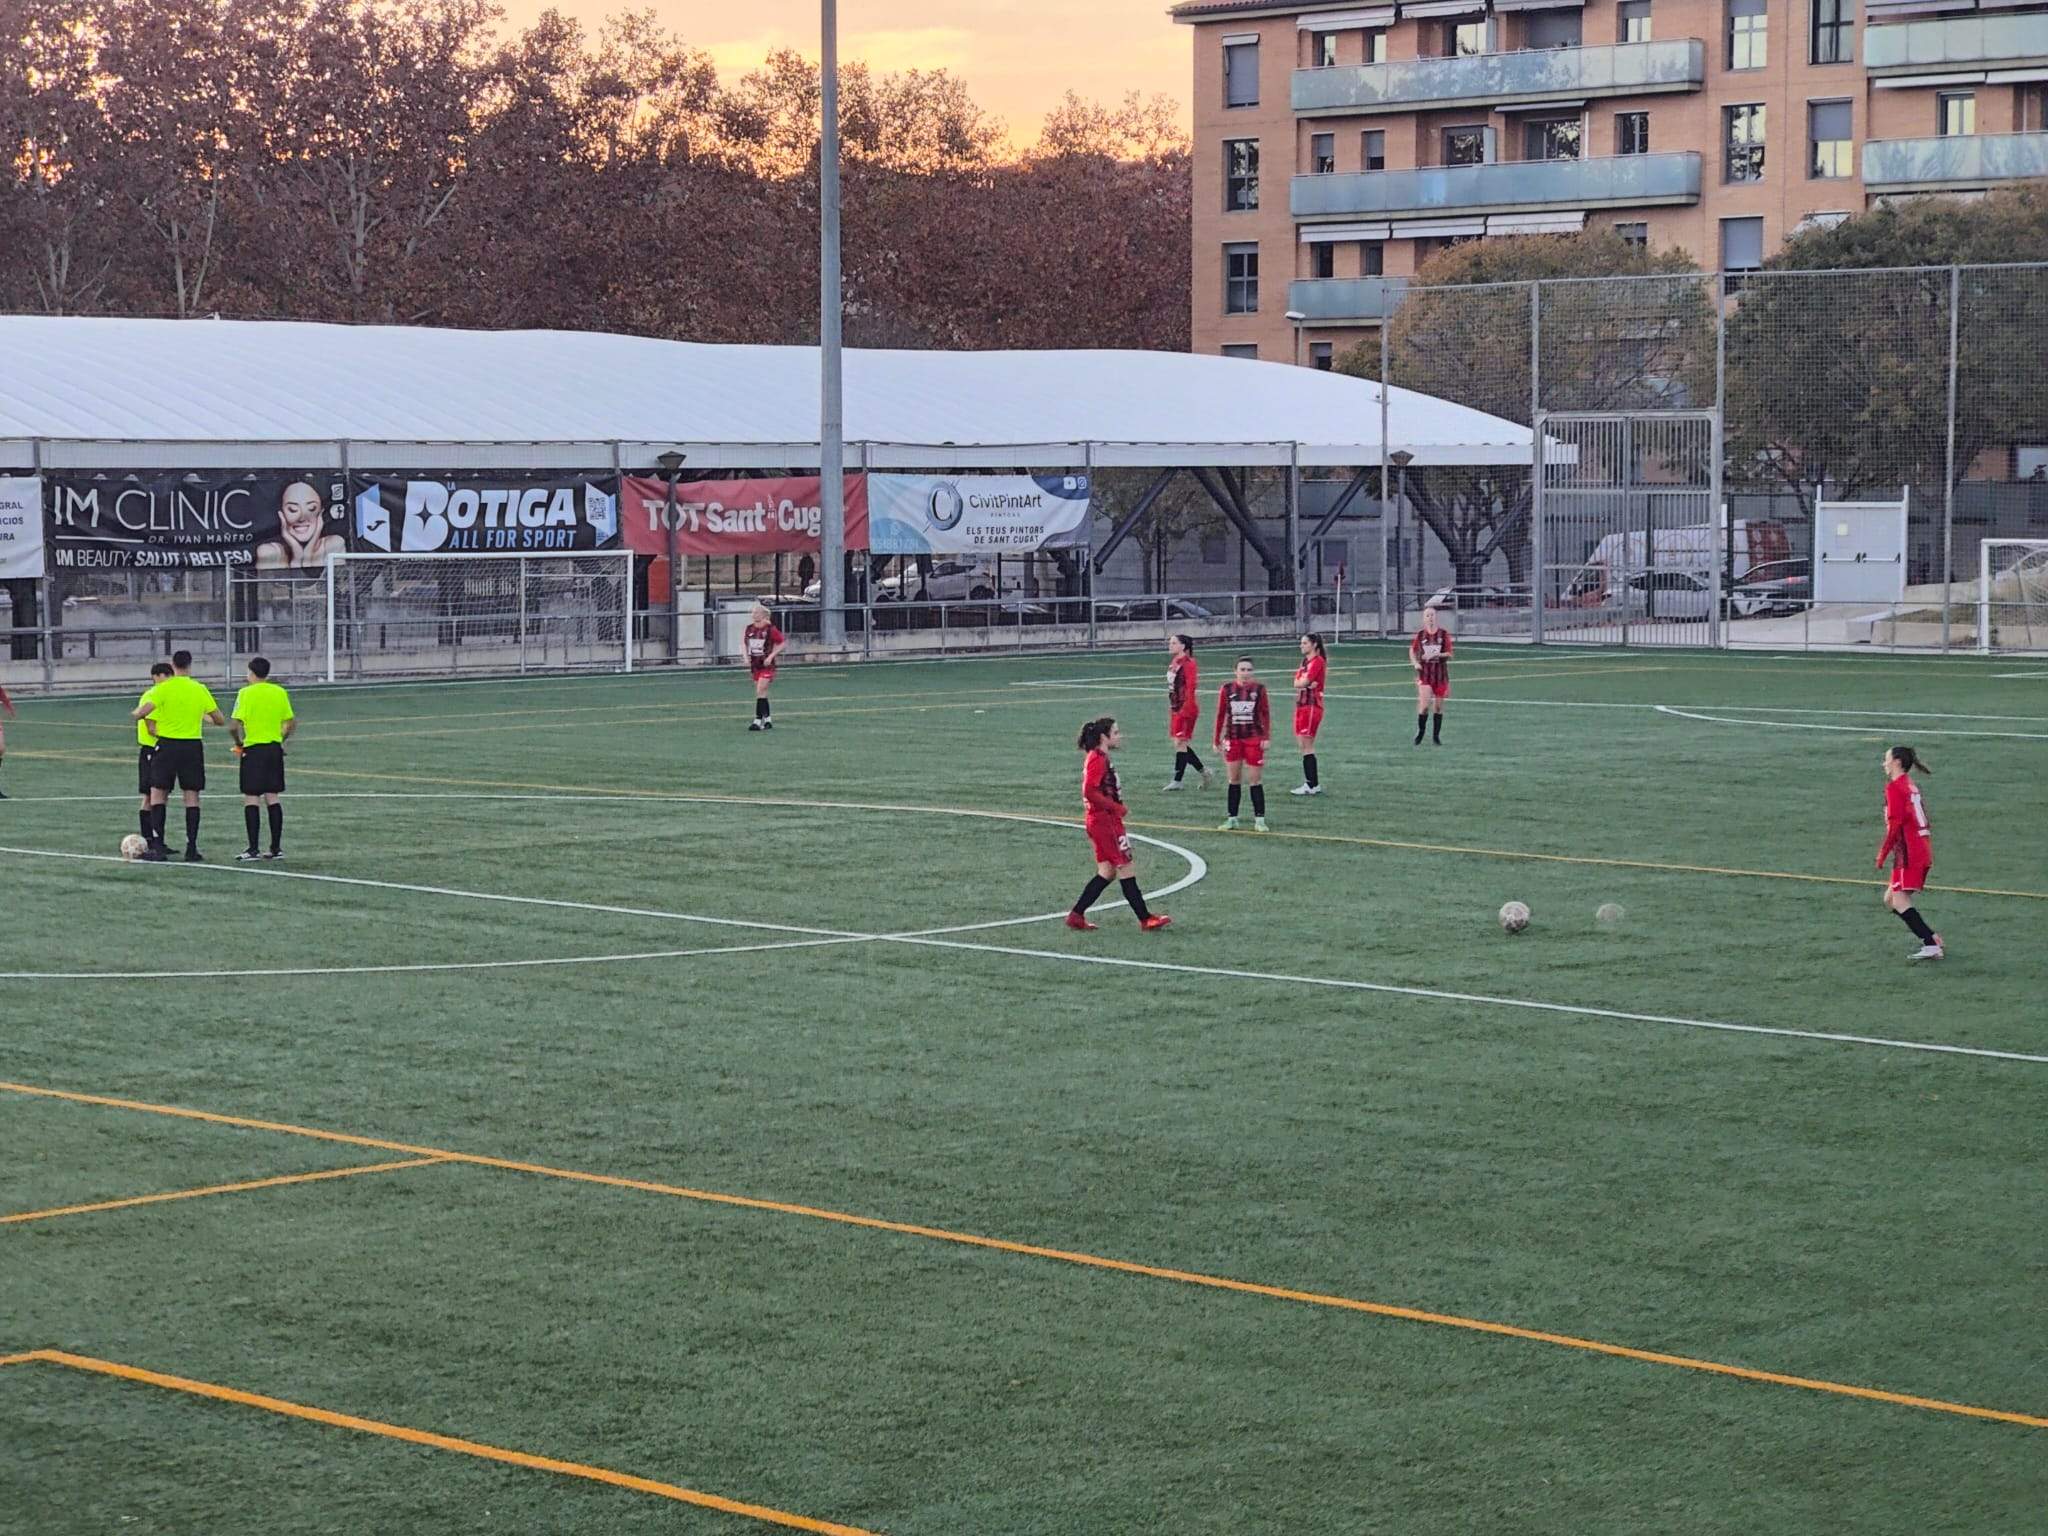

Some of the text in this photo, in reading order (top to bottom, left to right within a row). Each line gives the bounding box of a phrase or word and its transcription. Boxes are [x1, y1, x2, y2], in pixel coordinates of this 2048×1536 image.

[54, 486, 252, 530] IM CLINIC
[969, 494, 1042, 508] CivitPintArt
[400, 481, 577, 551] BOTIGA
[779, 499, 848, 537] Cug
[174, 534, 201, 544] IVAN
[448, 530, 479, 549] ALL
[485, 529, 517, 549] FOR
[522, 529, 577, 549] SPORT
[966, 526, 1044, 536] ELS TEUS PINTORS
[974, 536, 984, 544] DE
[988, 536, 1010, 545] SANT
[56, 549, 74, 566] IM
[77, 549, 133, 567] BEAUTY:
[134, 550, 180, 567] SALUT
